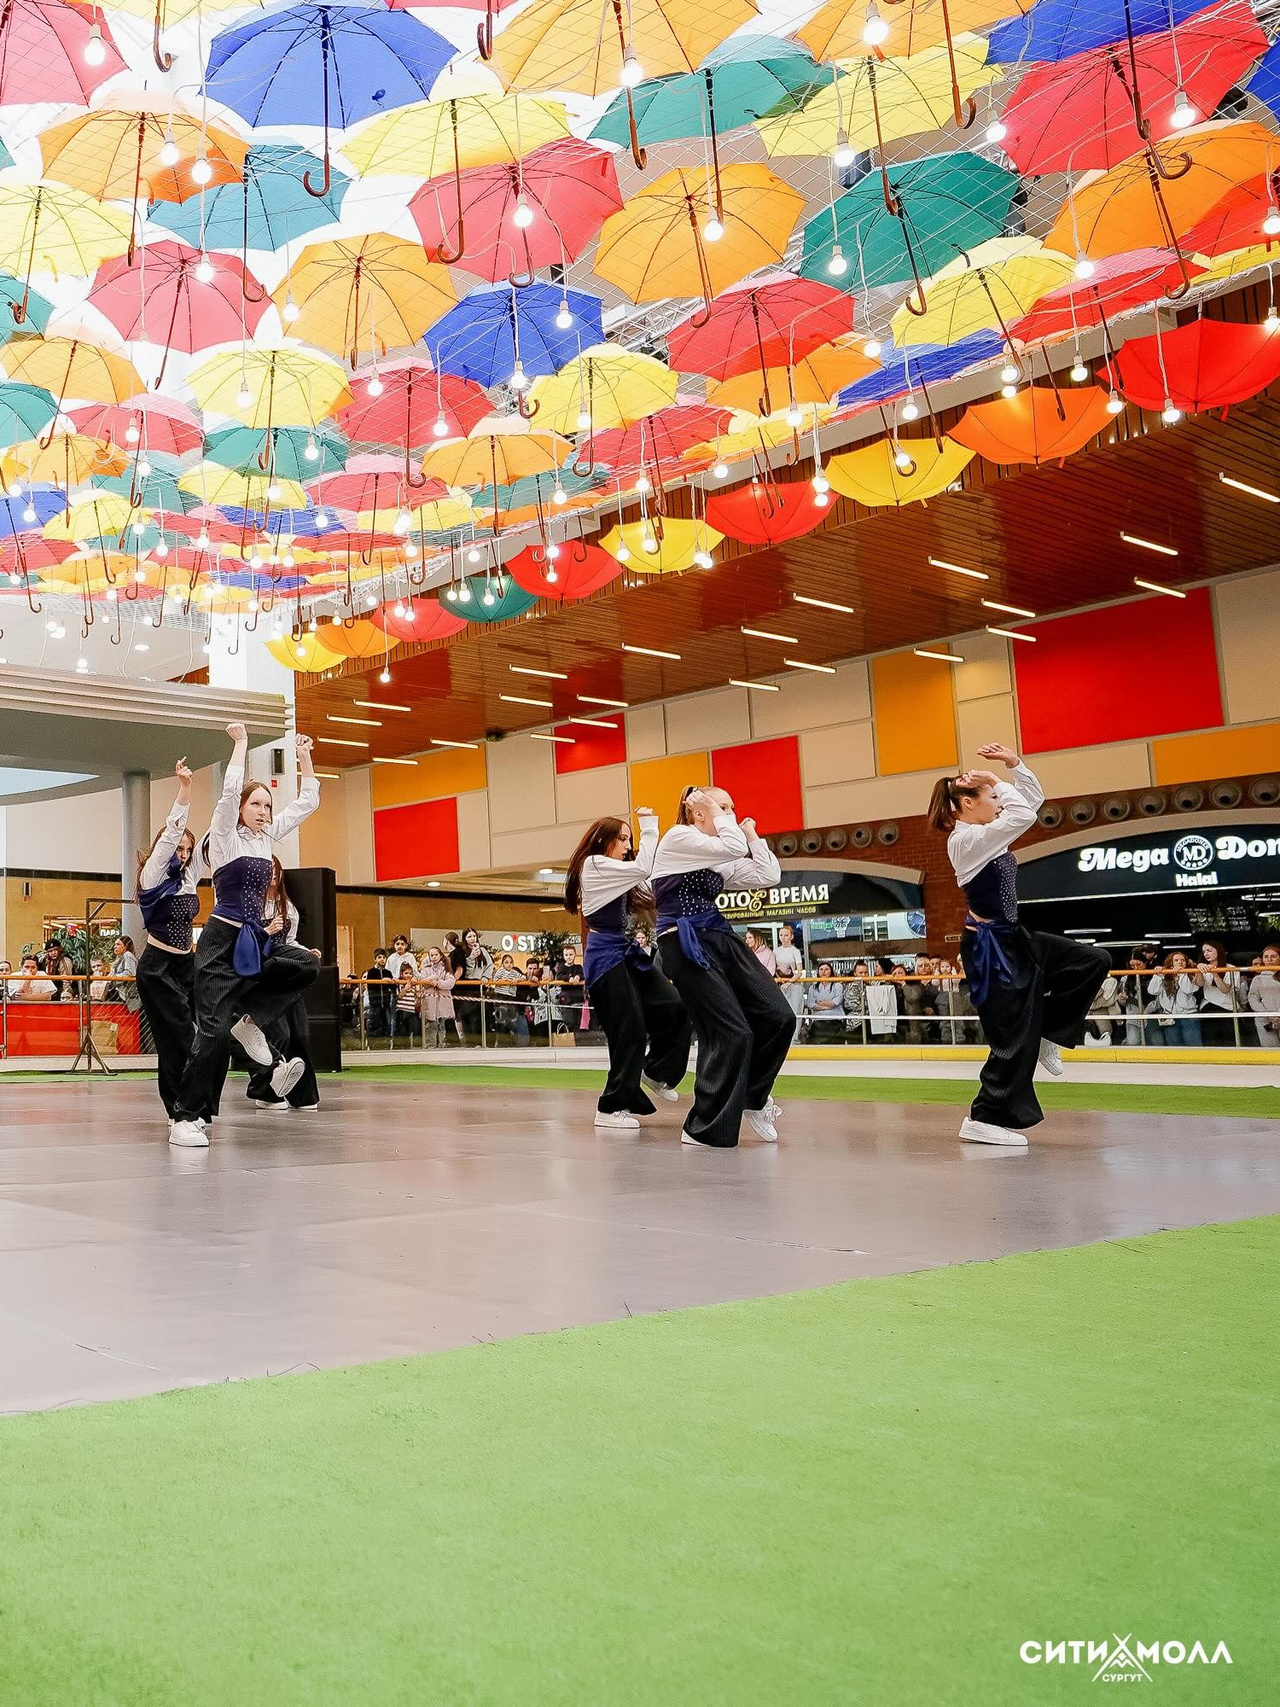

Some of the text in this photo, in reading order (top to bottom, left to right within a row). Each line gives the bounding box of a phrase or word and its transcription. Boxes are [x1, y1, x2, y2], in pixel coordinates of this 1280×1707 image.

[1078, 847, 1170, 873] Mega
[1182, 845, 1207, 861] MD
[1175, 871, 1219, 887] Halal
[768, 884, 829, 905] ВРЕМЯ
[766, 908, 794, 917] МАГАЗИН
[796, 905, 817, 915] ЧАСОВ
